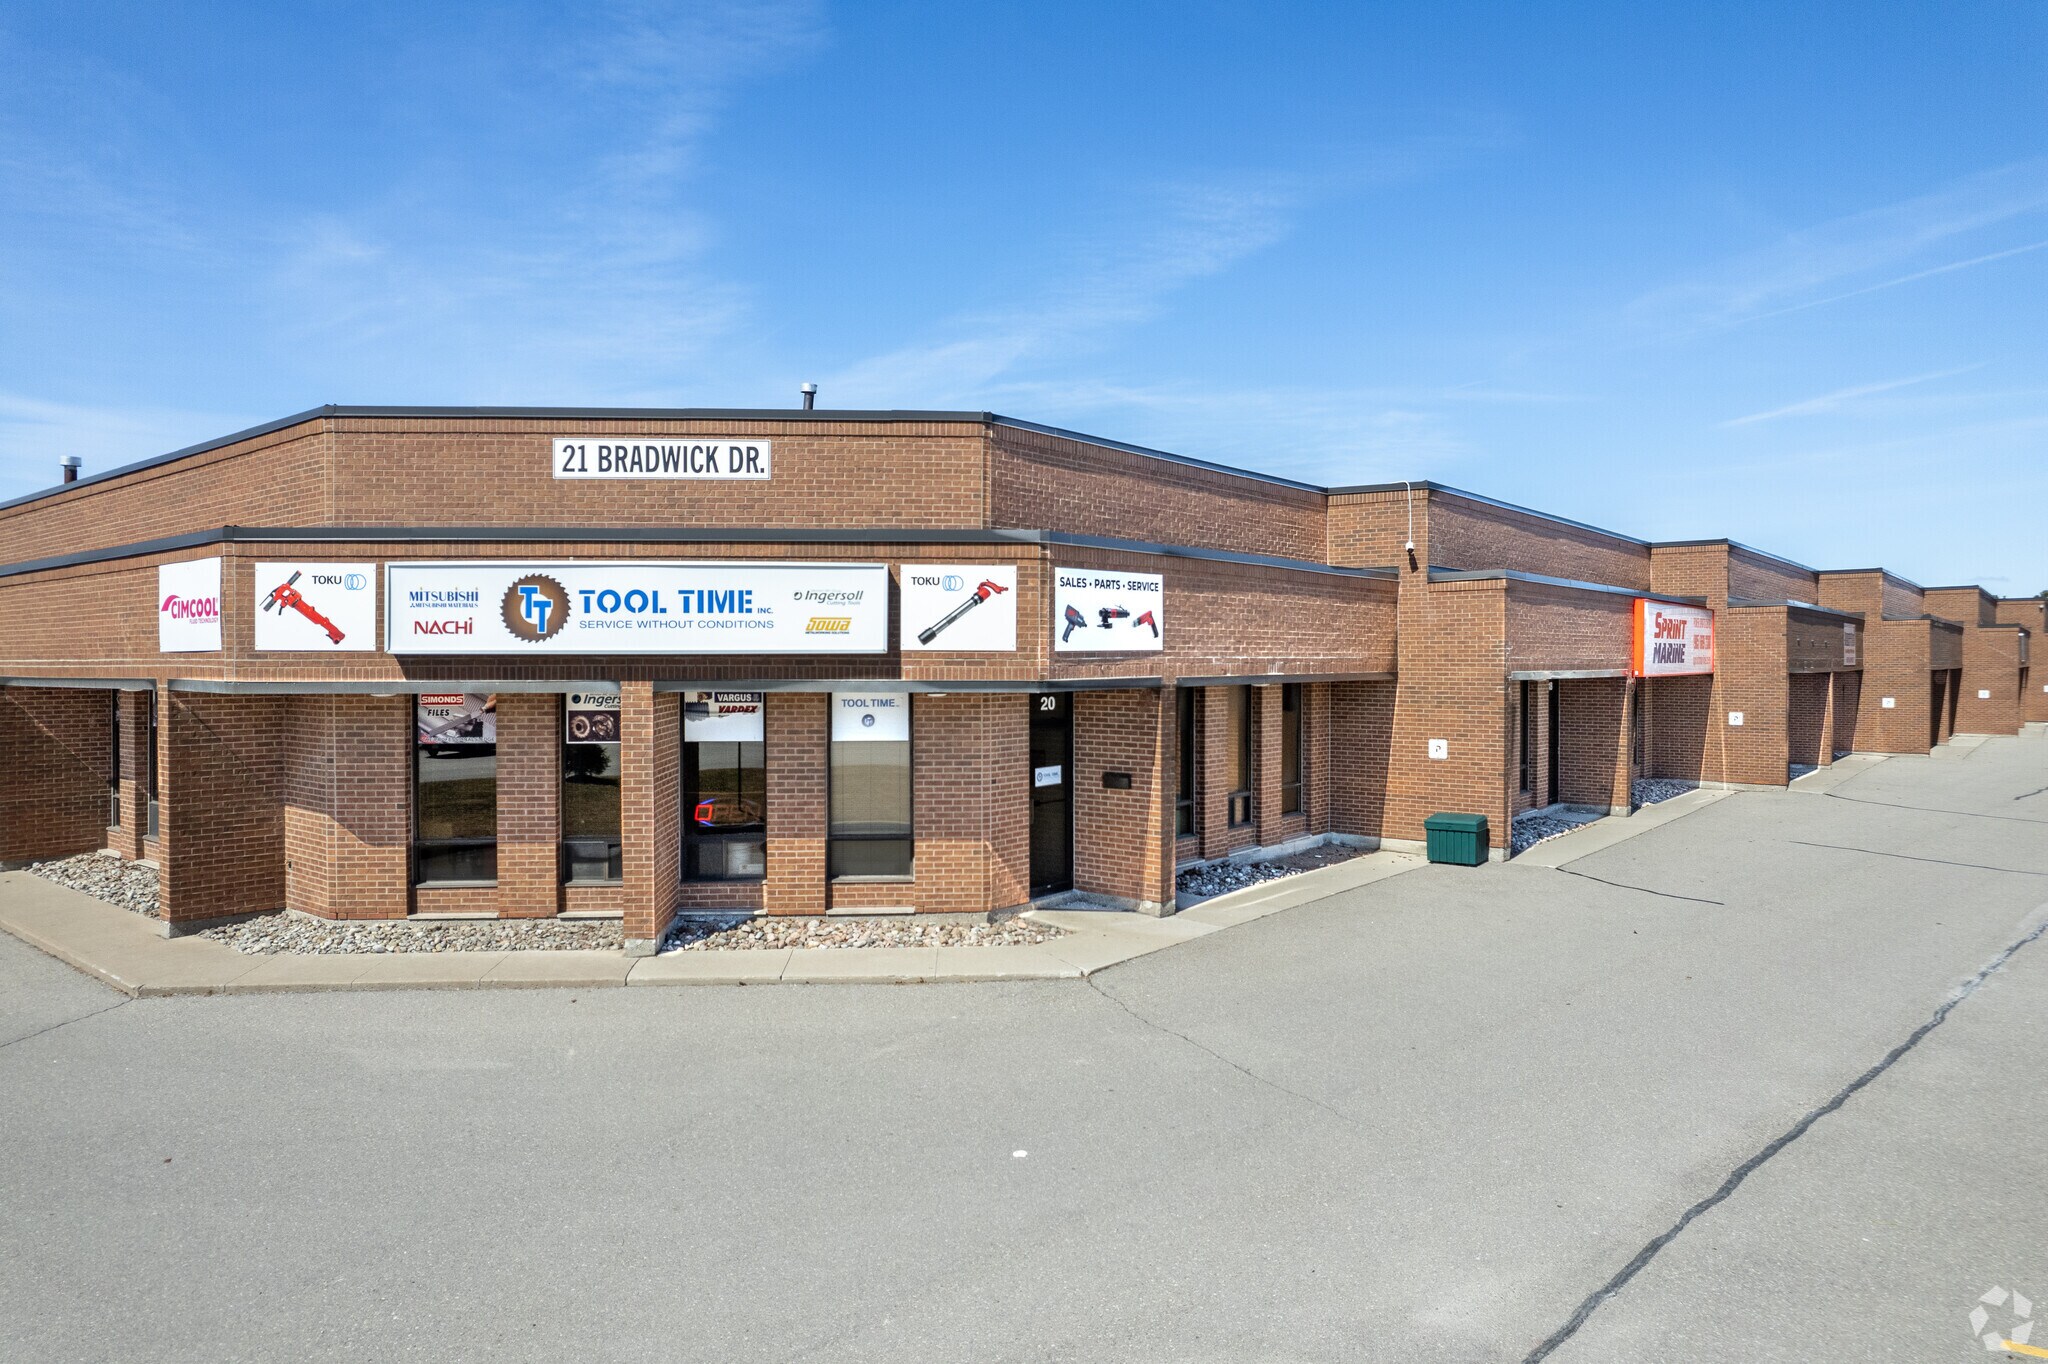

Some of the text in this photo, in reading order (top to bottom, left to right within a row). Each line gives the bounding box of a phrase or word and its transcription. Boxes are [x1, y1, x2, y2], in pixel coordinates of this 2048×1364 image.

[562, 444, 765, 474] 21 BRADWICK DR.
[312, 575, 342, 585] TOKU
[911, 576, 940, 586] TOKU
[1060, 577, 1159, 592] SALES PARTS SERVICE
[579, 589, 667, 613] TOOL
[678, 589, 753, 613] TIME
[805, 590, 864, 604] Ingersoll
[171, 597, 219, 619] CIMCOOL
[579, 620, 774, 629] SERVICE WITHOUT CONDITIONS
[1654, 612, 1687, 640] SPRINT
[1652, 643, 1686, 664] MARINE
[421, 696, 463, 704] SIMONDS
[717, 693, 752, 702] VARGUS
[841, 699, 896, 708] TOOL TIME
[1040, 696, 1056, 711] 20
[718, 705, 758, 713] VARDEX
